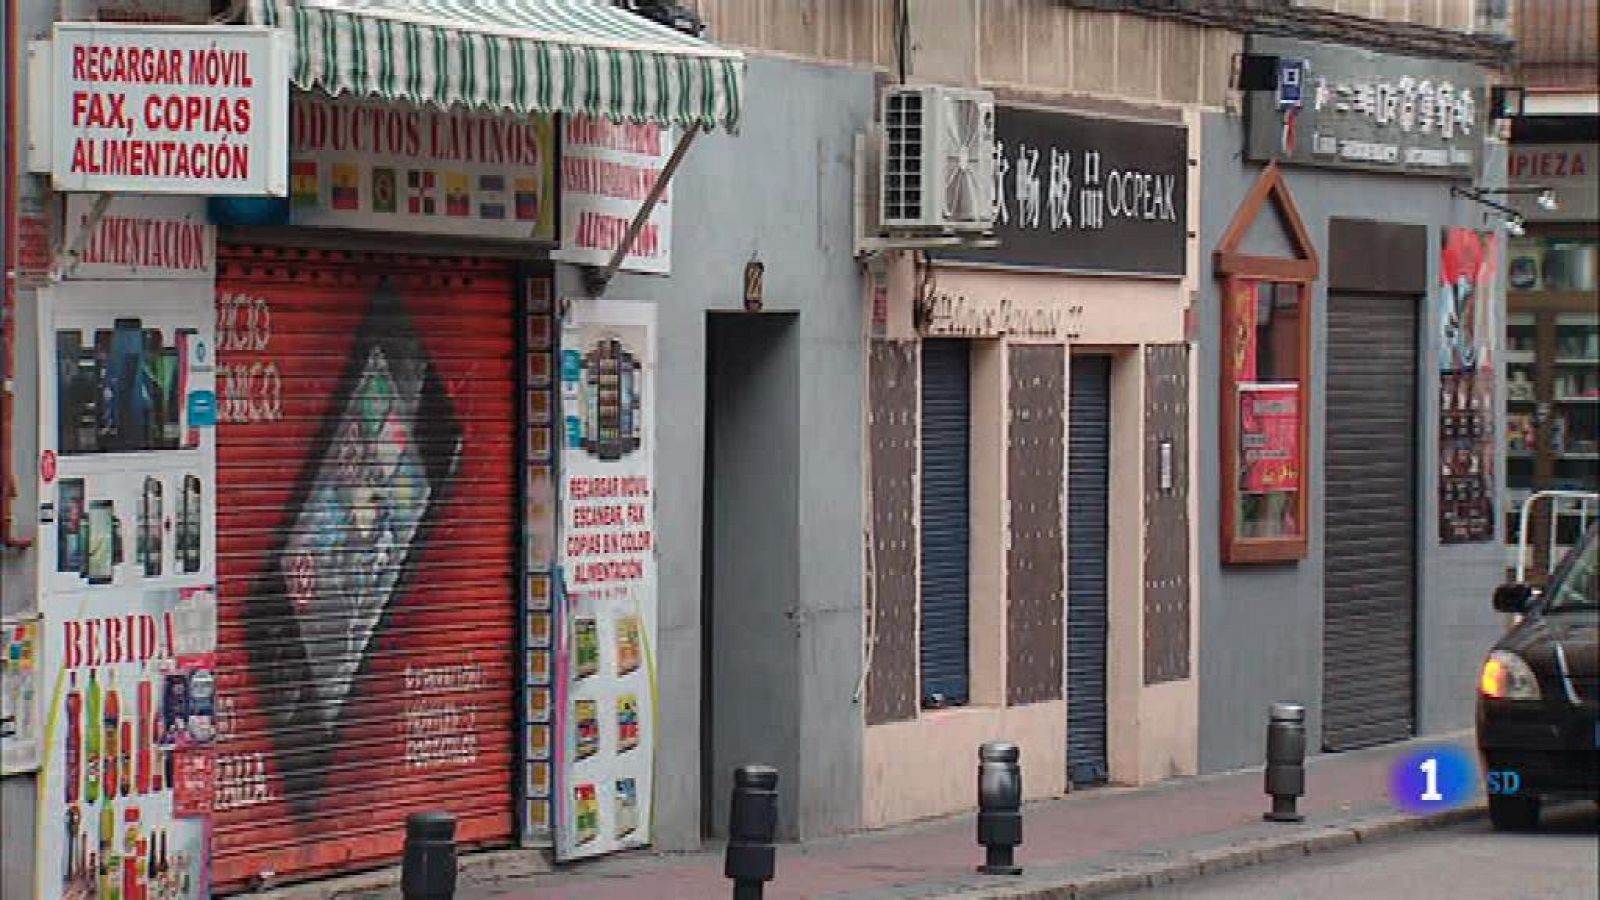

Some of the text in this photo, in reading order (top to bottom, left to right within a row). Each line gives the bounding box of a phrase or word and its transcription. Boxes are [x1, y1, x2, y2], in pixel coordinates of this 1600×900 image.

[72, 41, 253, 88] RECARGAR MÓVIL
[72, 91, 251, 136] FAX, COPIAS
[71, 135, 249, 181] ALIMENTACIÓN
[428, 111, 539, 167] LATINOS
[1107, 169, 1176, 222] OCPEAK
[570, 477, 618, 499] RECARGAR
[628, 503, 645, 523] FAX
[567, 533, 600, 557] COPIAS
[621, 531, 650, 553] COLOR
